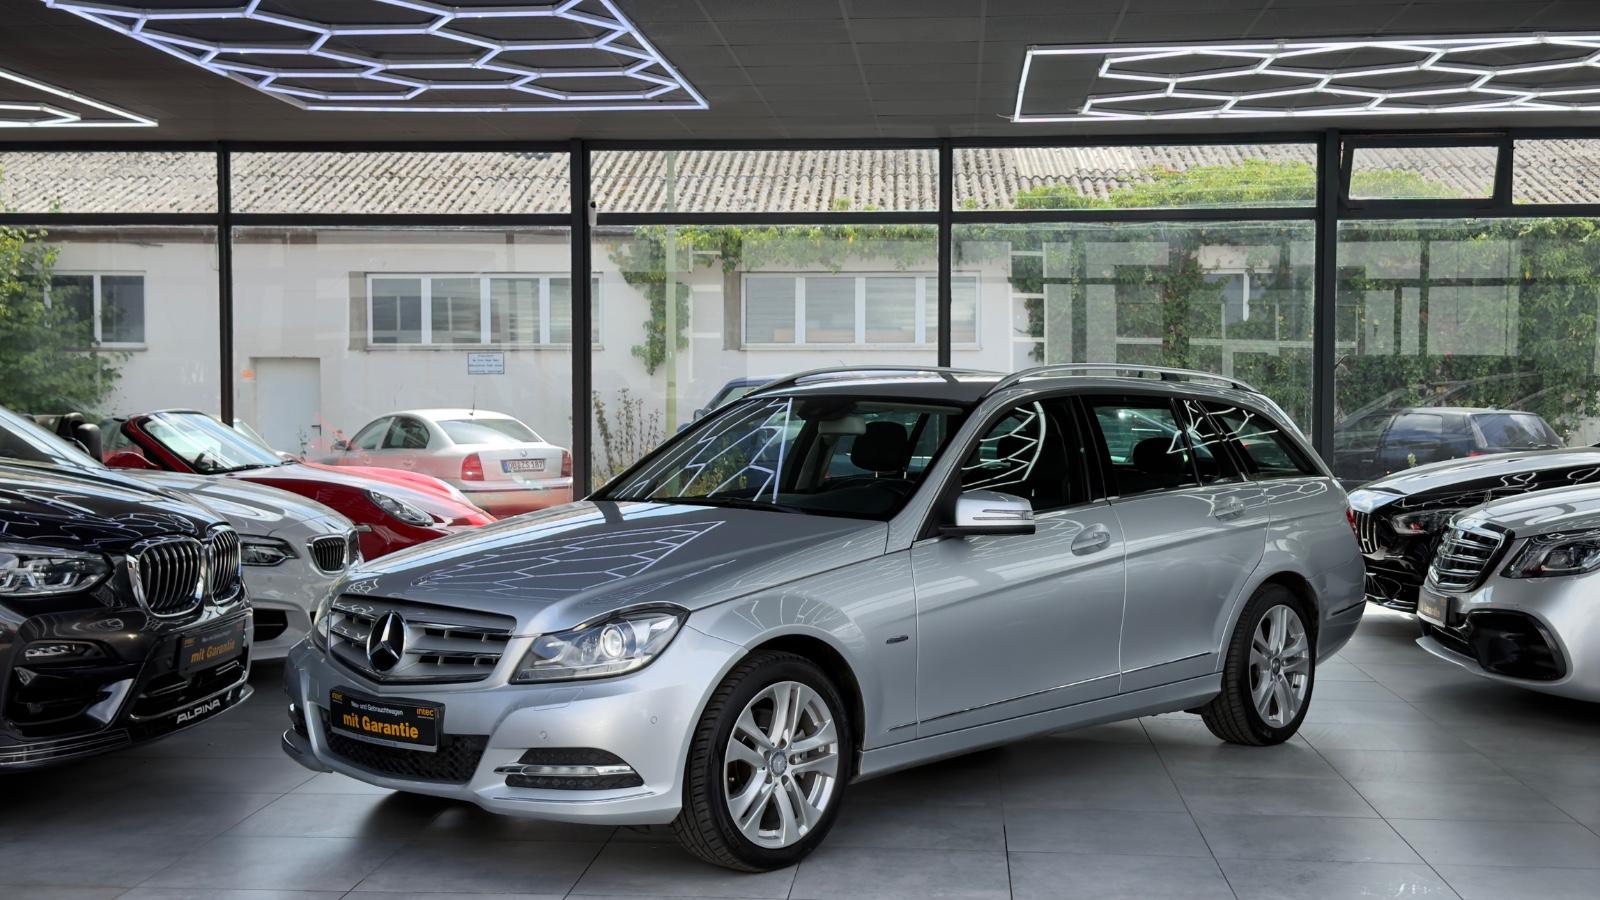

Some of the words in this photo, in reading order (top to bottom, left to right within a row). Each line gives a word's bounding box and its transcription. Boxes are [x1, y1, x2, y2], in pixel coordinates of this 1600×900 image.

[191, 648, 205, 663] mit
[176, 699, 221, 724] ALPINA
[367, 704, 404, 717] Gebrauchtwagen
[416, 708, 434, 717] intec
[343, 713, 360, 729] mit
[362, 716, 419, 739] Garantie
